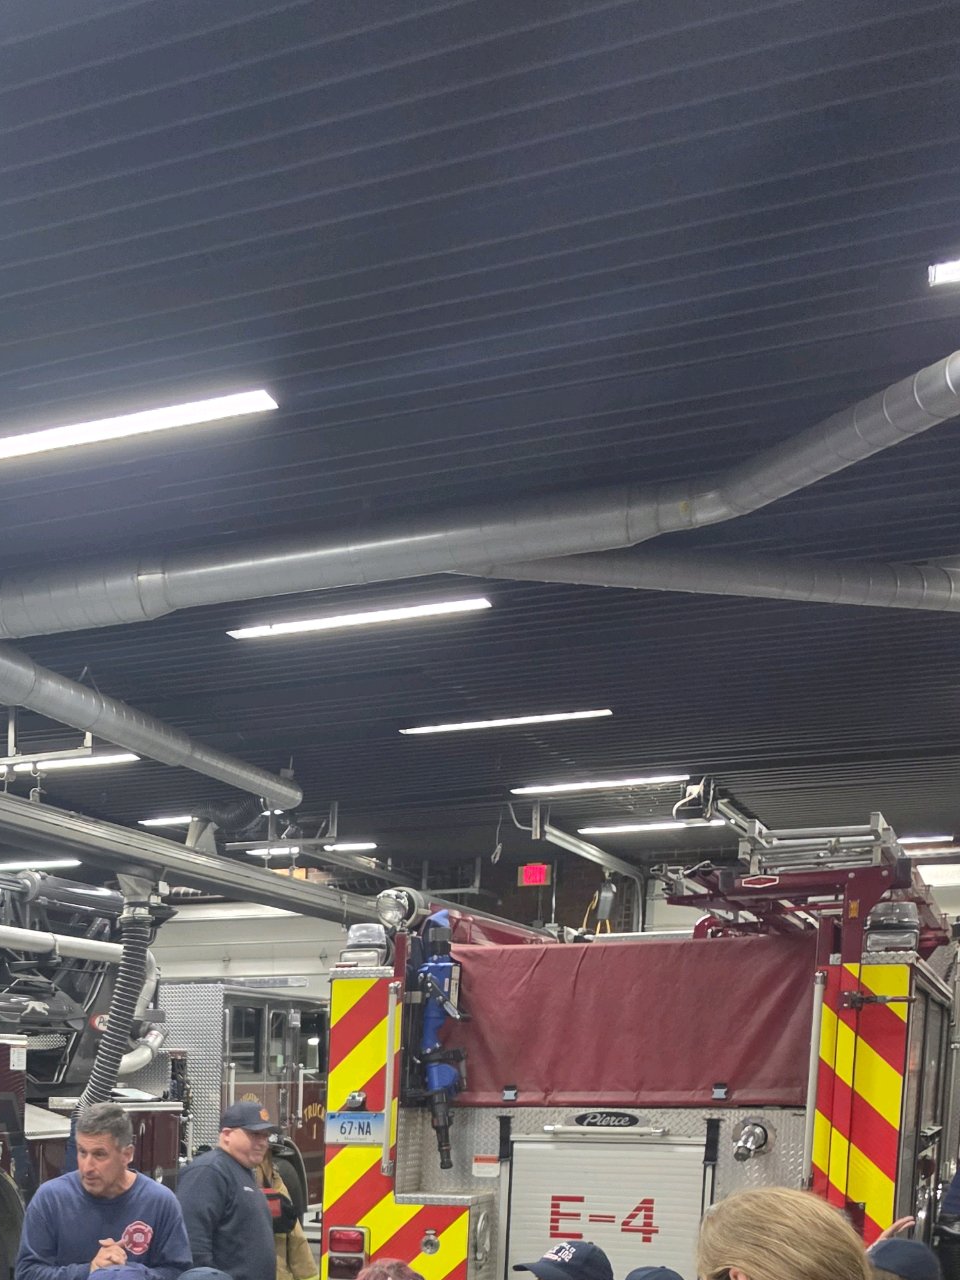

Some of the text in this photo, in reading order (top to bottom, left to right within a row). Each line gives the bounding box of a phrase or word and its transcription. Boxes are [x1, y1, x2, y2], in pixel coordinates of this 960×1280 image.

[583, 1112, 631, 1127] Pierce
[549, 1195, 660, 1243] E-4
[558, 1248, 573, 1262] 102
